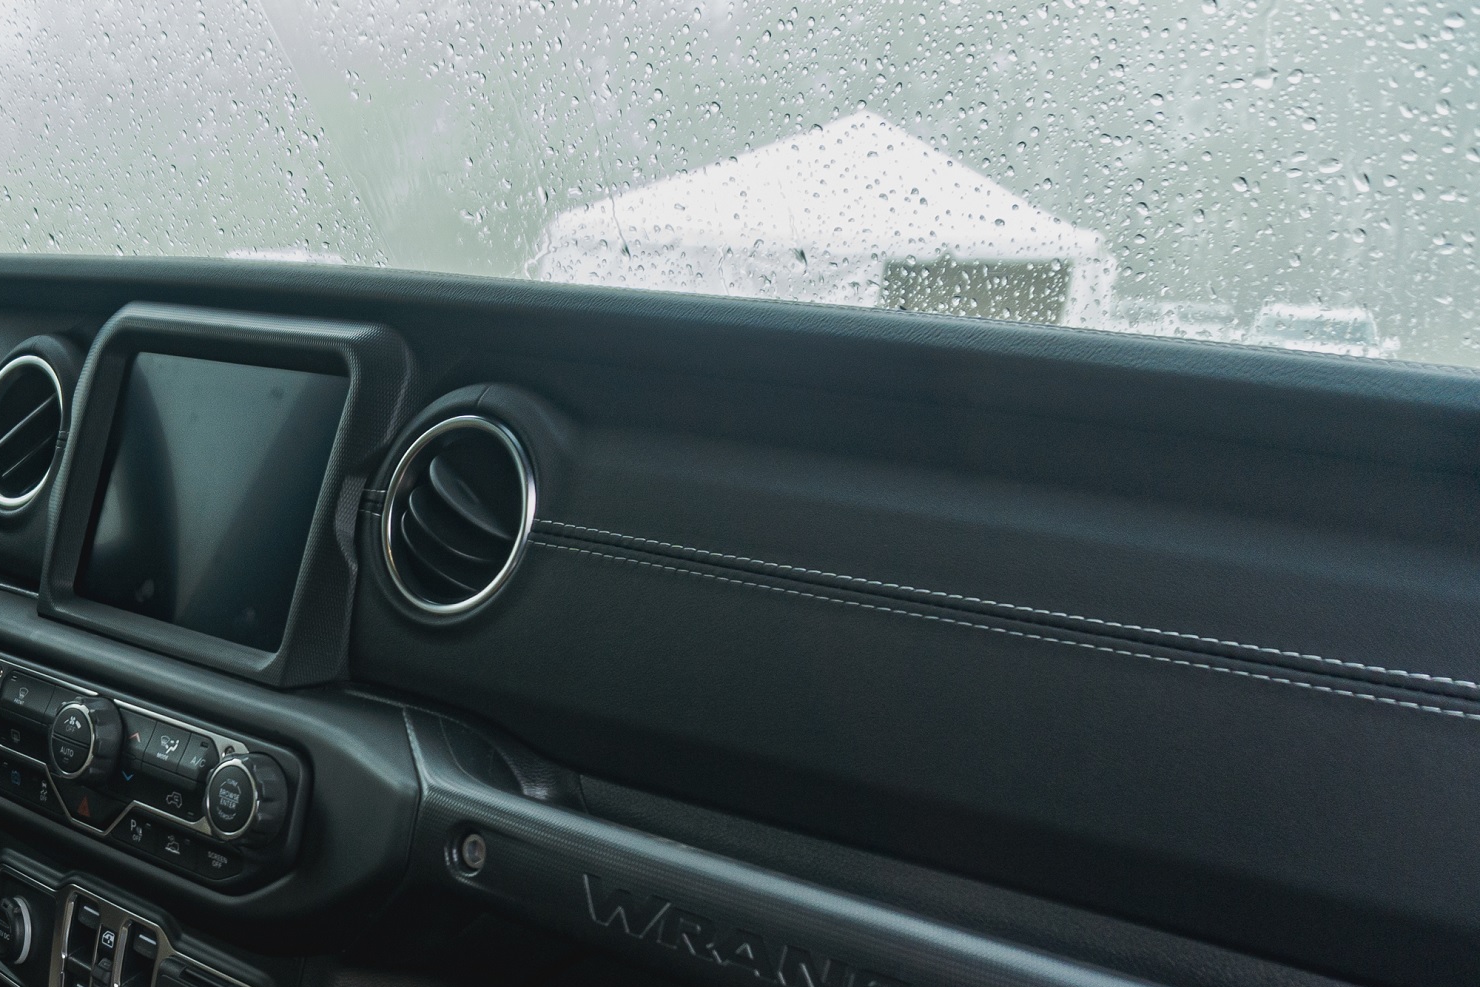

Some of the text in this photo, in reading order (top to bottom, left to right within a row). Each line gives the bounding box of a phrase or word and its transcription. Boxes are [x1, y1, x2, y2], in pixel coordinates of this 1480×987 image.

[59, 745, 74, 758] AUTO
[156, 751, 169, 761] MODE
[189, 755, 206, 769] A/C
[218, 787, 240, 802] BROWSE
[219, 797, 237, 810] ENTER
[207, 850, 228, 865] SCREEN
[211, 860, 222, 870] OFF
